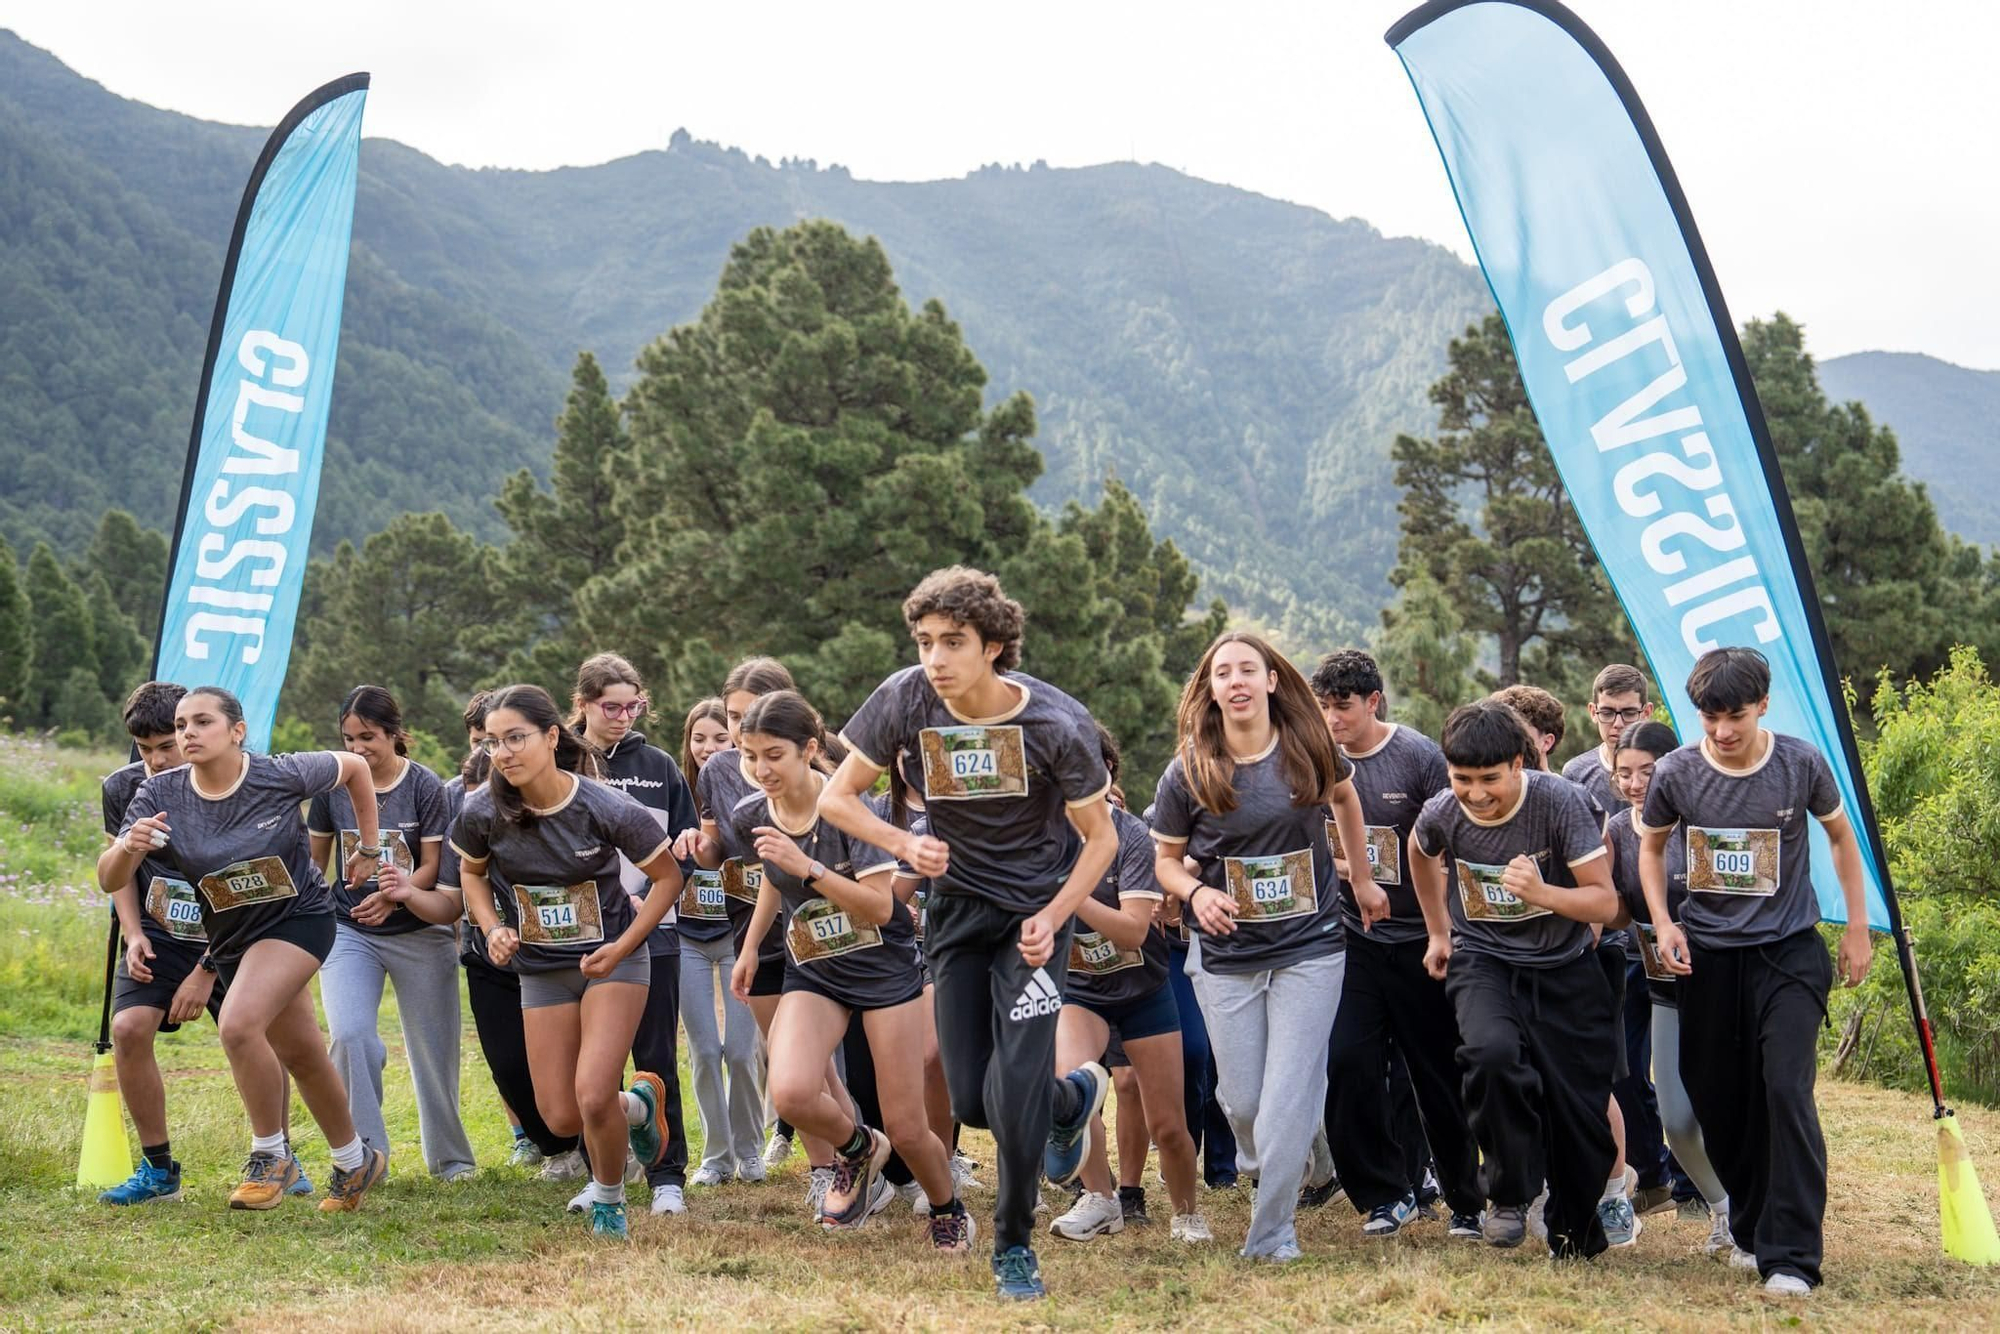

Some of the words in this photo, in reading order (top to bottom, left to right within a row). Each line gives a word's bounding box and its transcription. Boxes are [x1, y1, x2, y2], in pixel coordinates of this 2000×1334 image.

[185, 330, 309, 665] CLASSIC
[955, 753, 993, 775] 624
[607, 776, 663, 792] mpion
[1717, 853, 1749, 872] 609
[230, 875, 264, 891] 628
[747, 871, 761, 888] 51
[1255, 879, 1289, 899] 634
[700, 889, 724, 903] 606
[1486, 885, 1516, 902] 613
[170, 902, 200, 922] 608
[541, 906, 573, 925] 514
[814, 916, 843, 938] 517
[1085, 944, 1111, 962] 513
